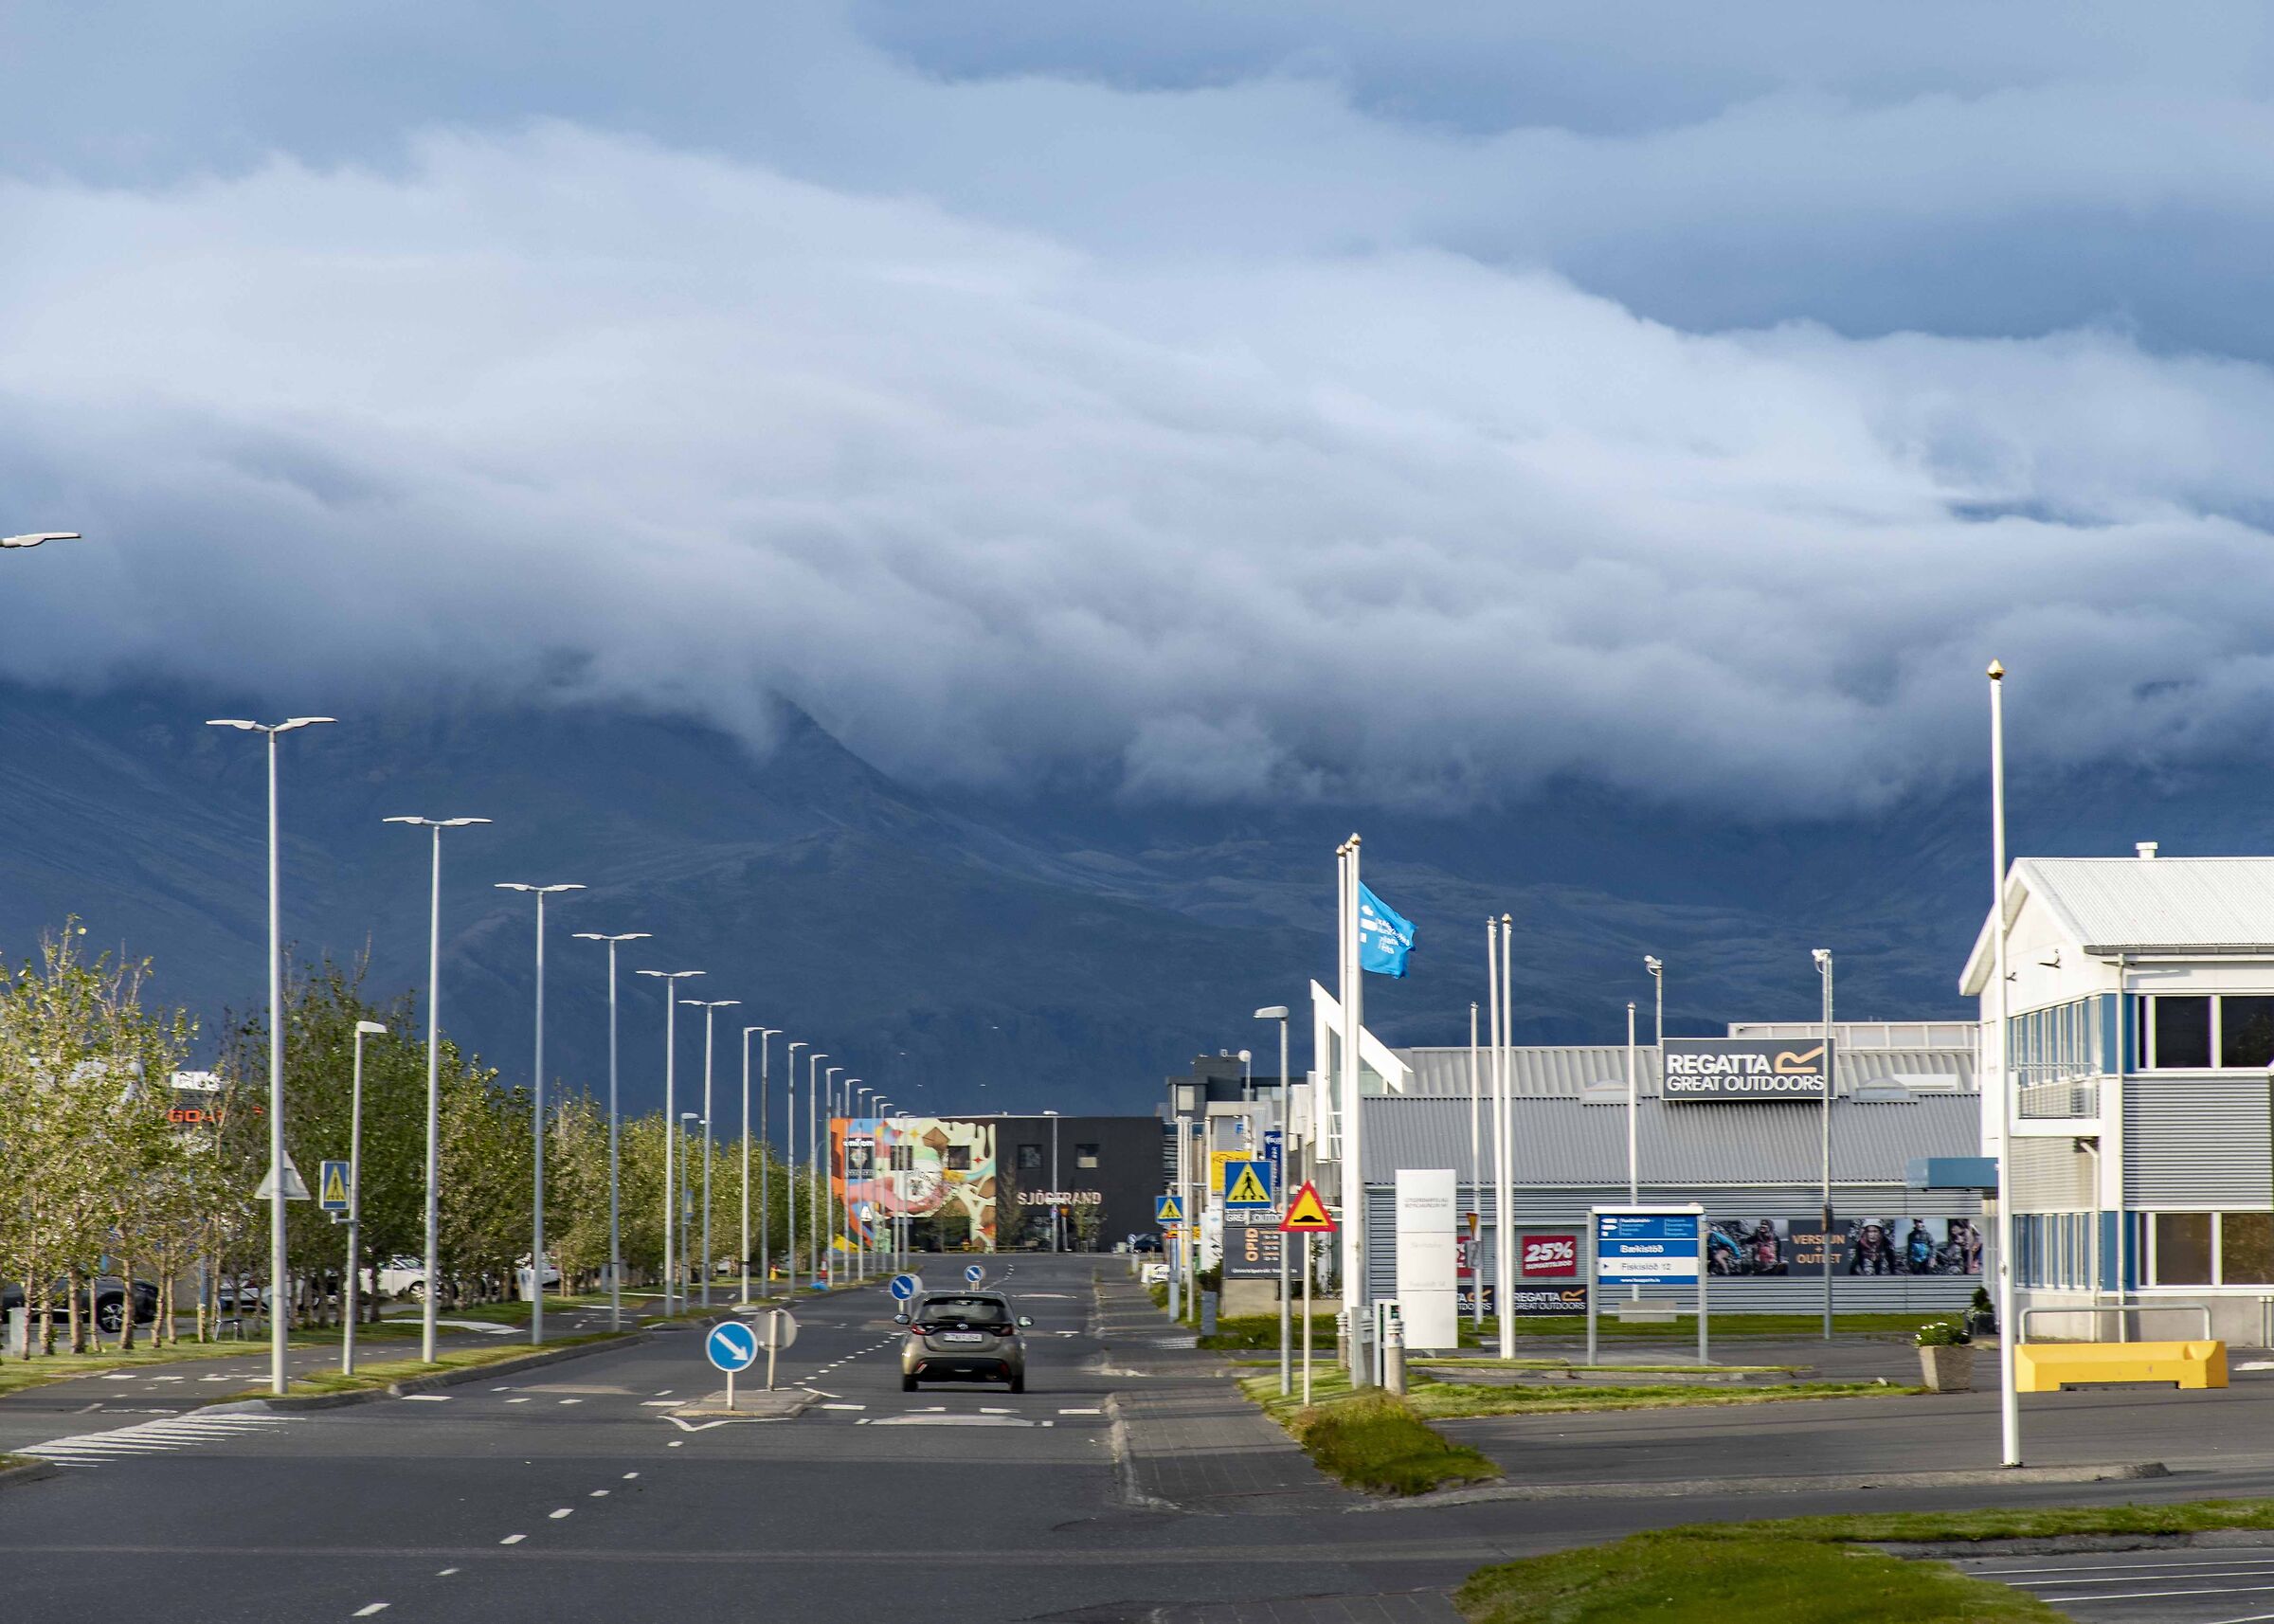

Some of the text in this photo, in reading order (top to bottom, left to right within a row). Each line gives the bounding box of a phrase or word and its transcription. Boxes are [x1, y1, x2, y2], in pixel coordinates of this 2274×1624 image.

[1667, 1054, 1773, 1074] REGATTA
[1667, 1075, 1825, 1092] GREAT OUTDOORS
[1525, 1241, 1574, 1262] 25%
[1514, 1291, 1561, 1302] REGATTA
